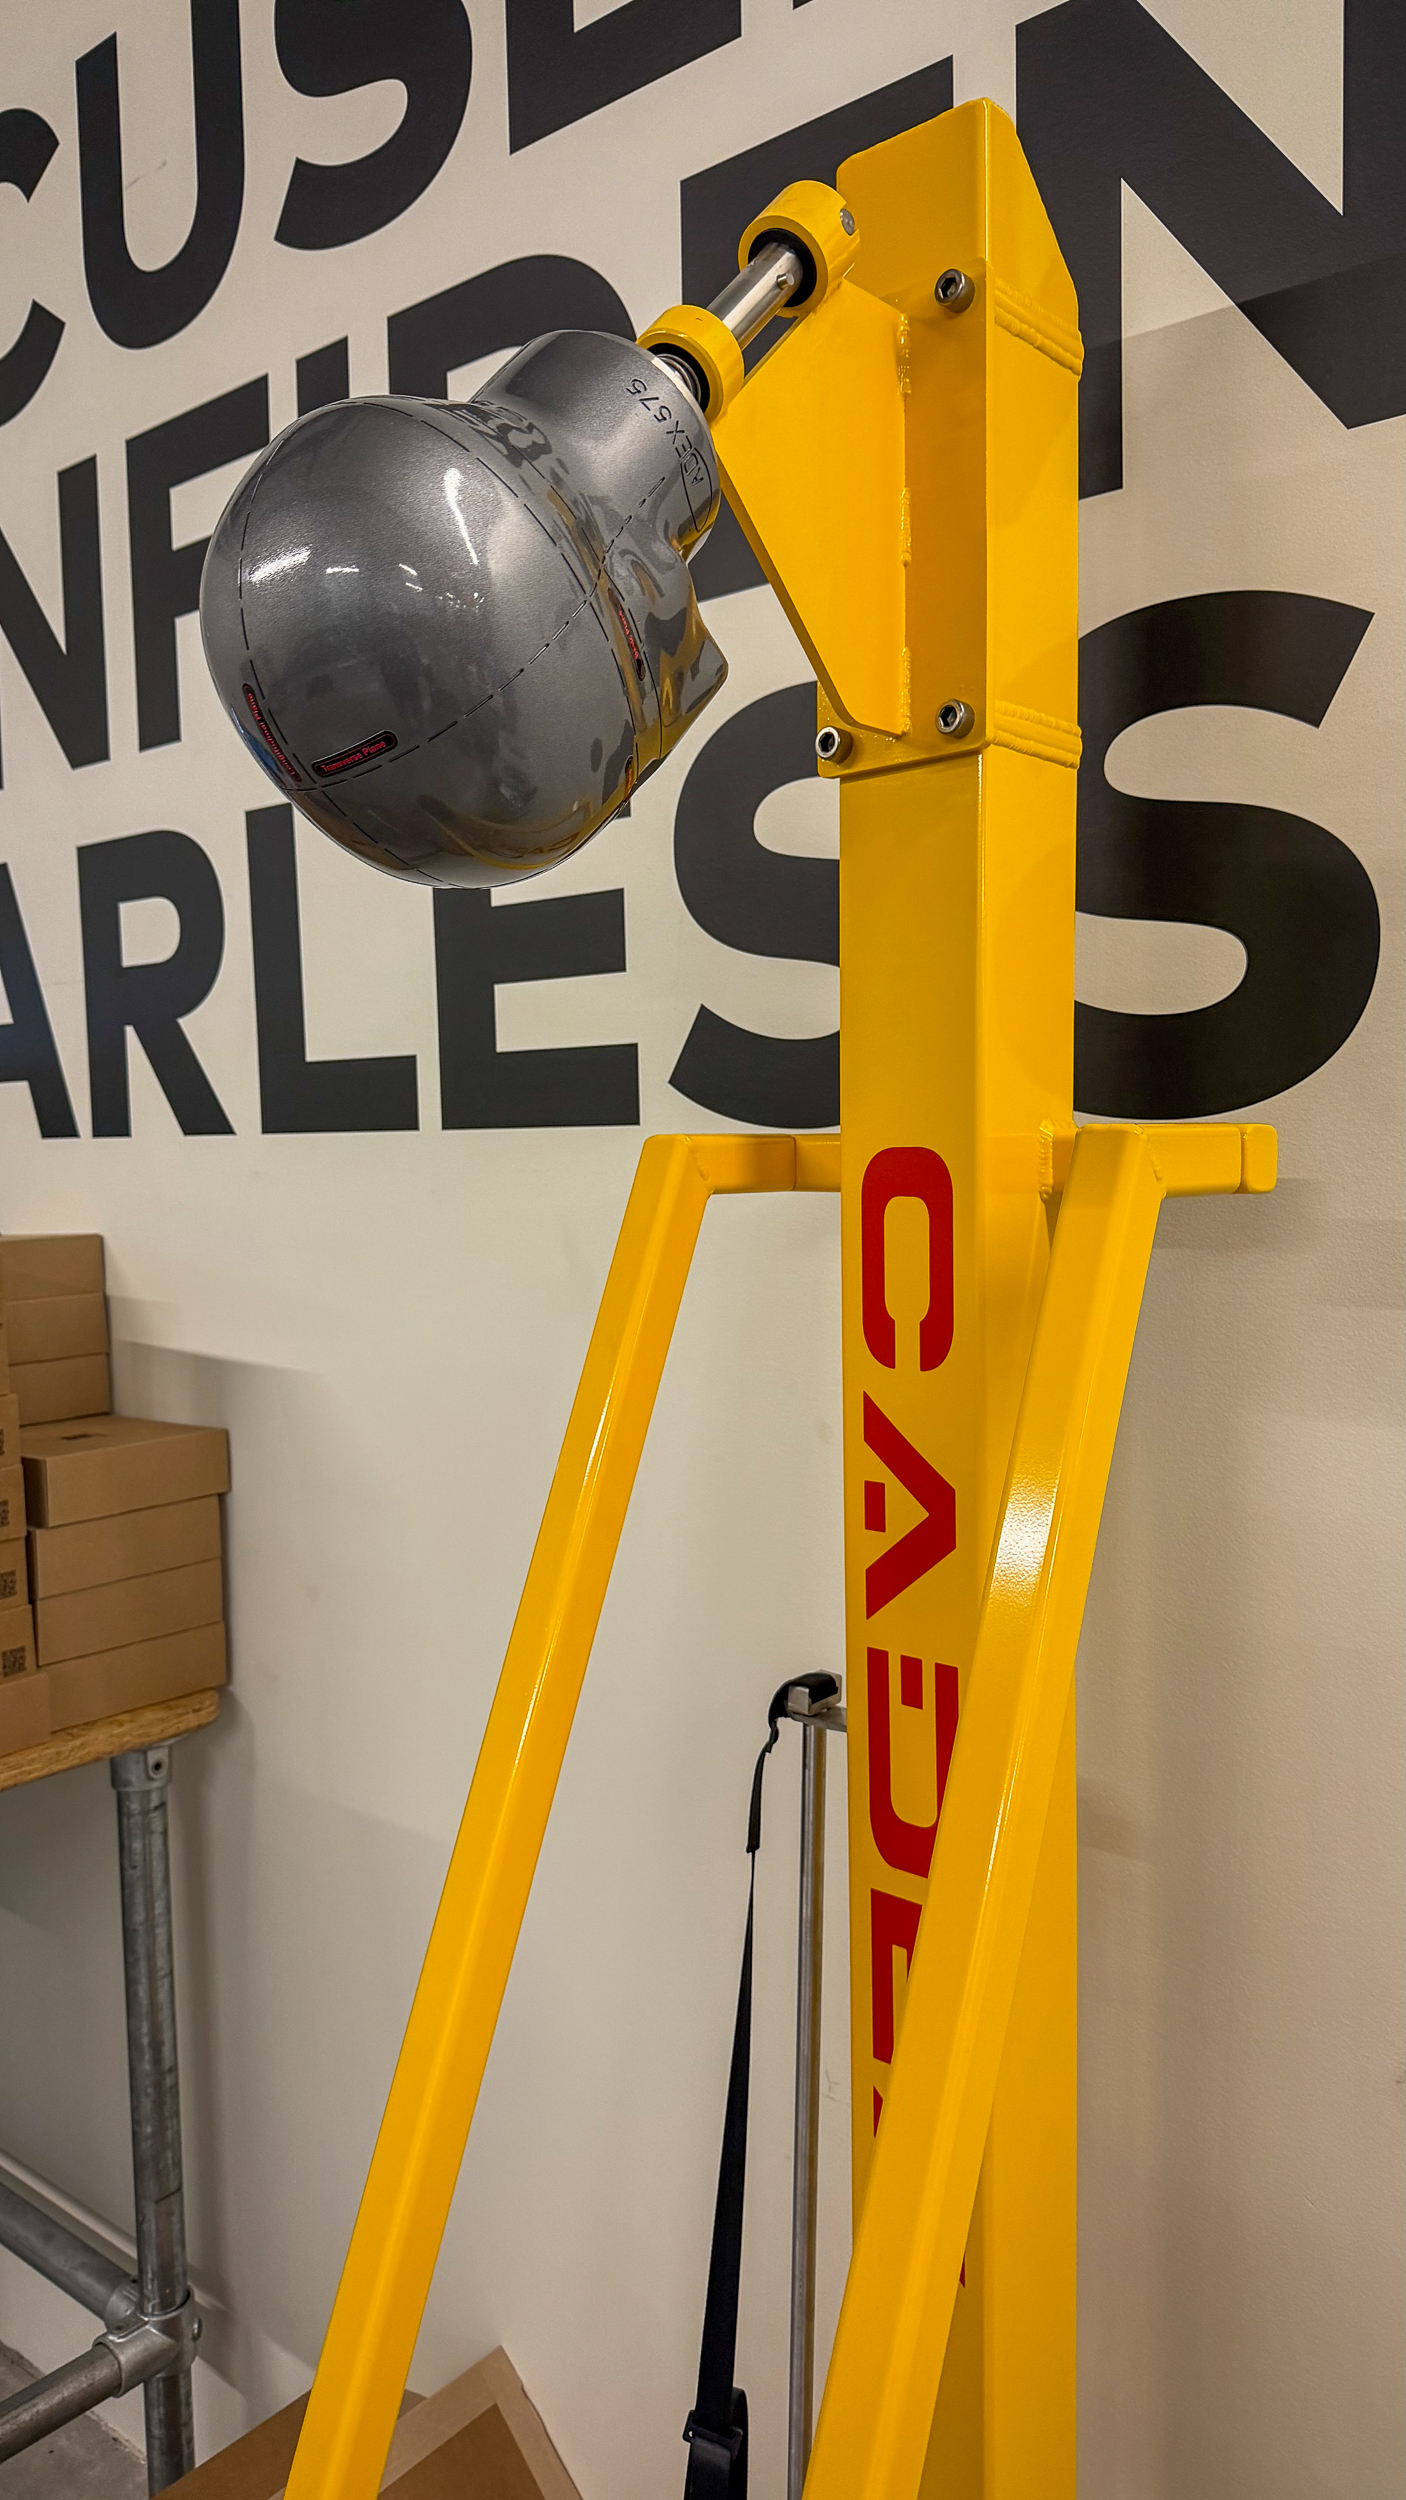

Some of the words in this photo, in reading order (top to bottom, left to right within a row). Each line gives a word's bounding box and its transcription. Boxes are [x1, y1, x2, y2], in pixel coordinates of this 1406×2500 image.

[247, 692, 263, 721] Plane
[320, 752, 363, 773] Transverse
[361, 740, 387, 757] Plane
[861, 1146, 966, 2288] CAD
